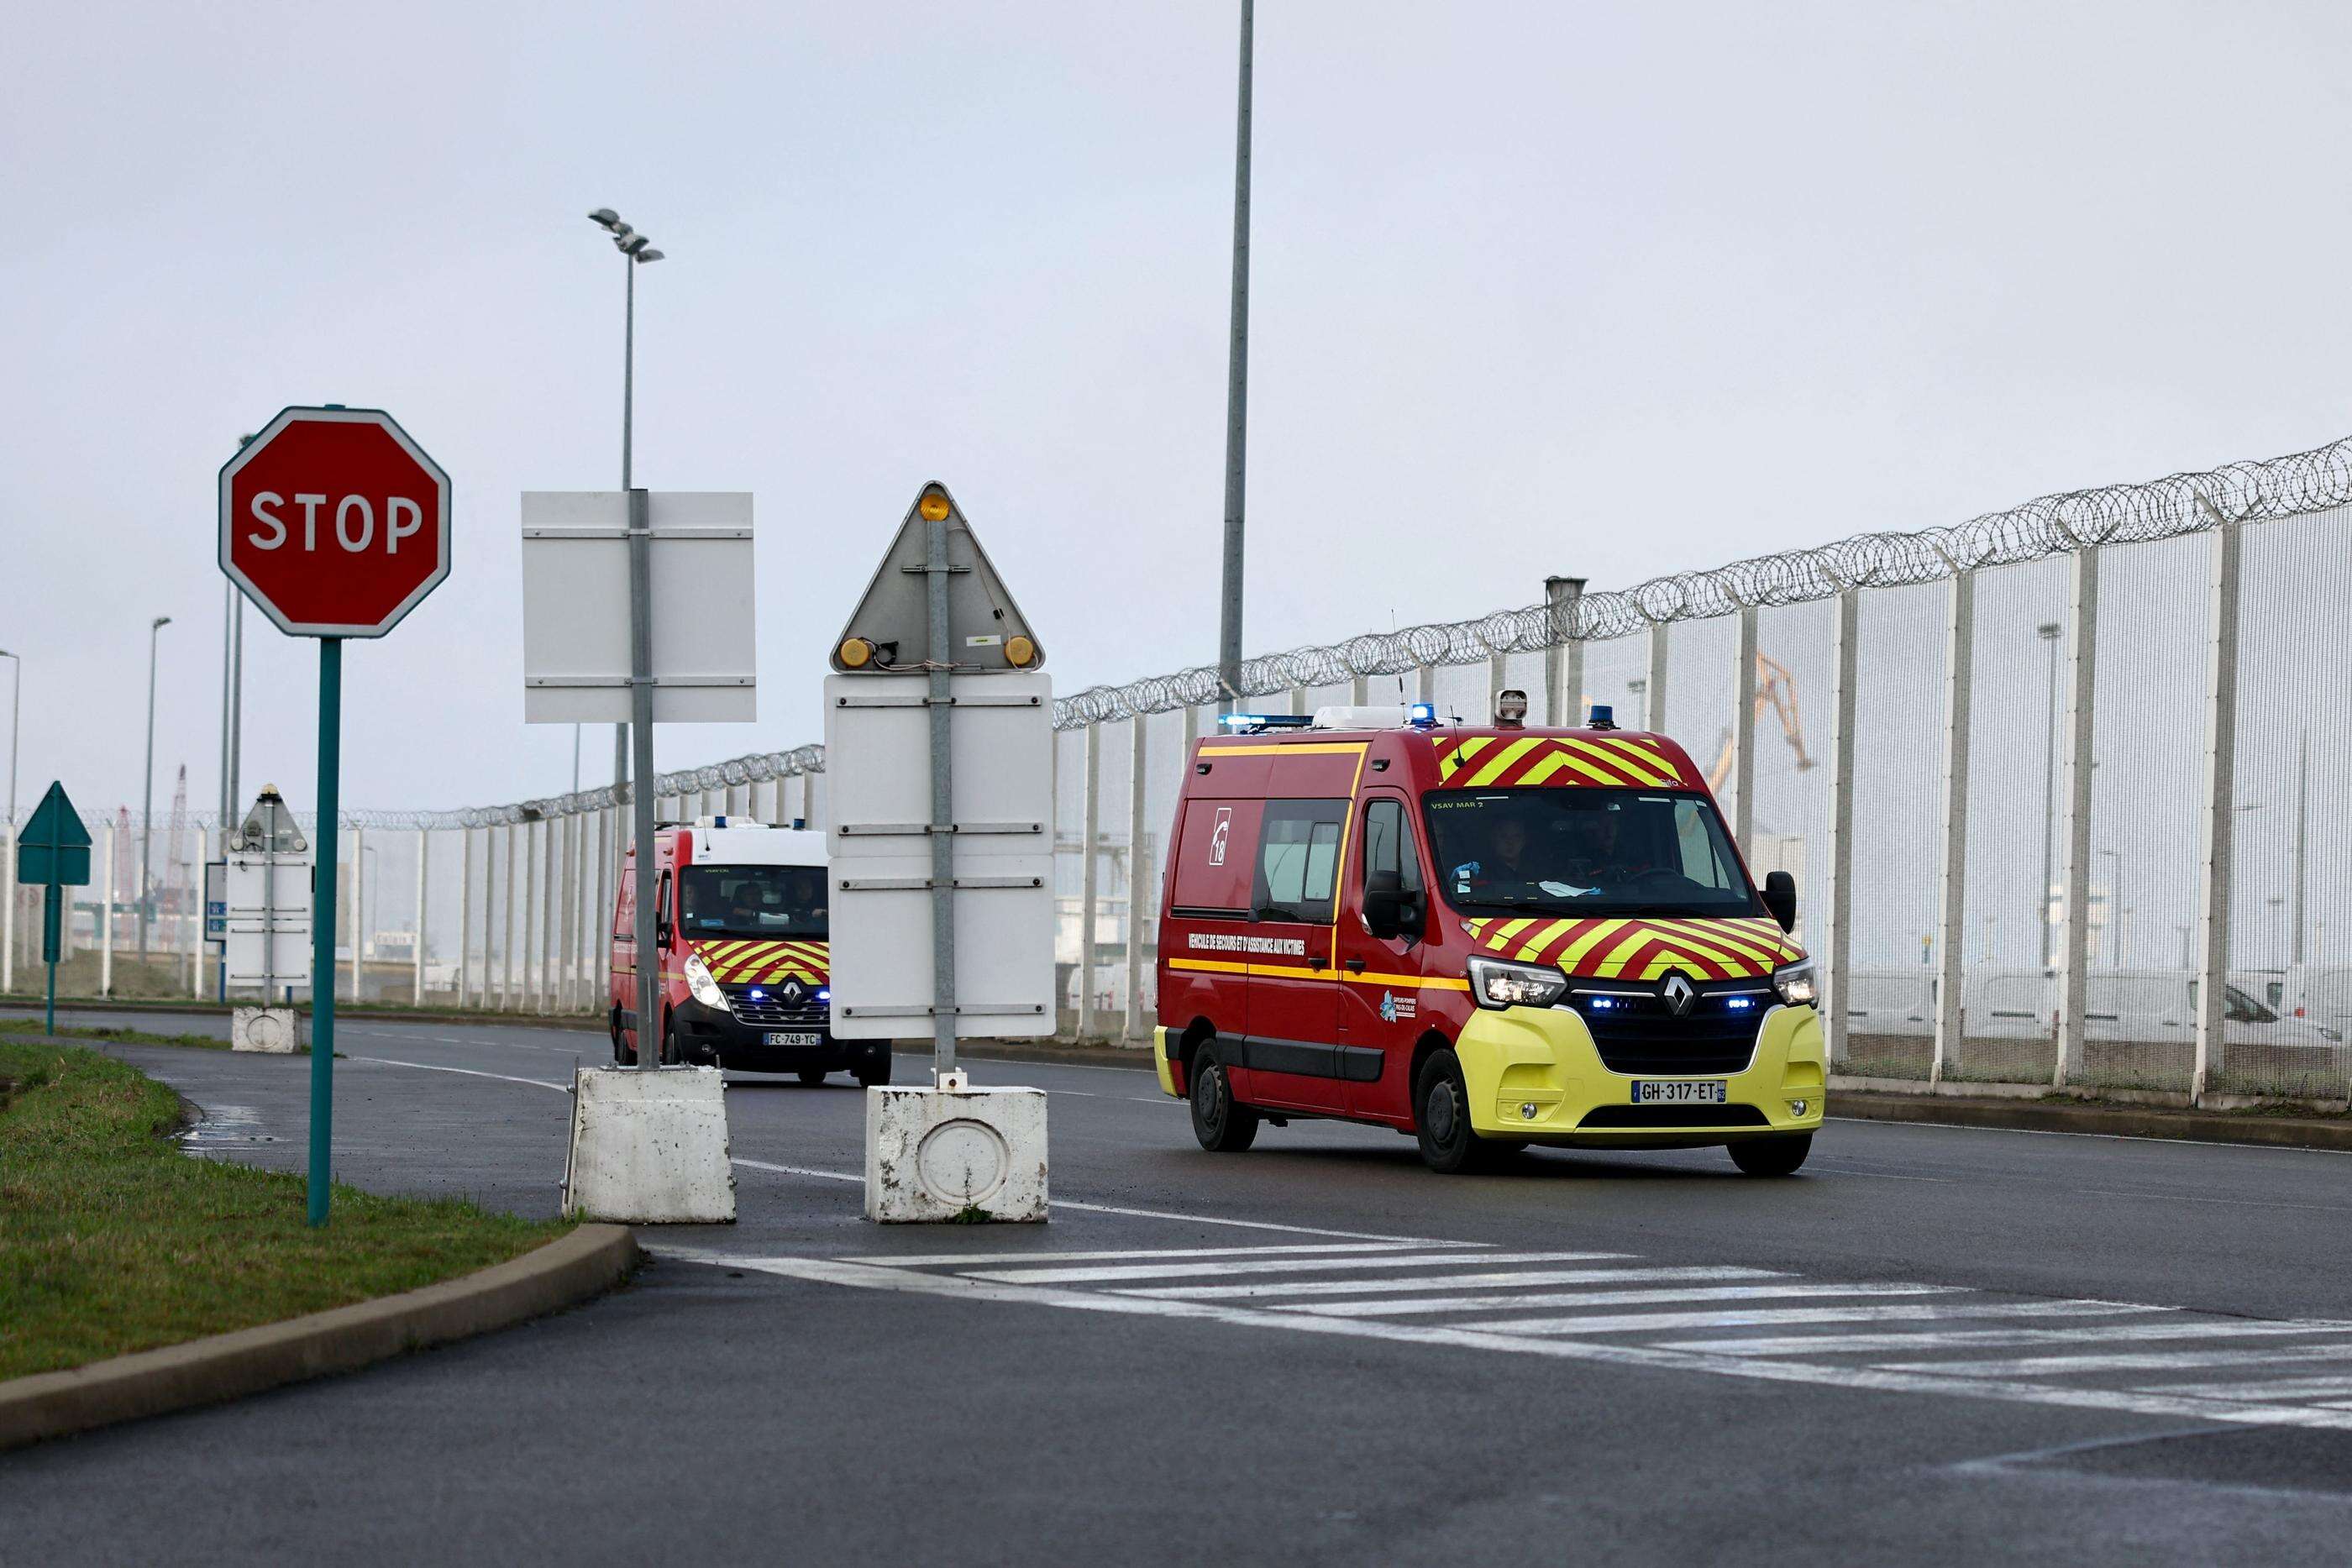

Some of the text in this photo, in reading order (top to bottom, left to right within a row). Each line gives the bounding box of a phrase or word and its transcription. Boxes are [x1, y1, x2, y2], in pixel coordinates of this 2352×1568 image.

[248, 490, 423, 554] STOP
[1215, 840, 1225, 862] 18
[1210, 934, 1216, 950] DE
[1216, 935, 1236, 951] SECOURS
[1236, 936, 1242, 952] ET
[1273, 938, 1284, 954] AUX
[1284, 939, 1305, 956] VICTIMES
[770, 1034, 816, 1044] FC-749-YC
[1642, 1083, 1715, 1100] GH-317-ET
